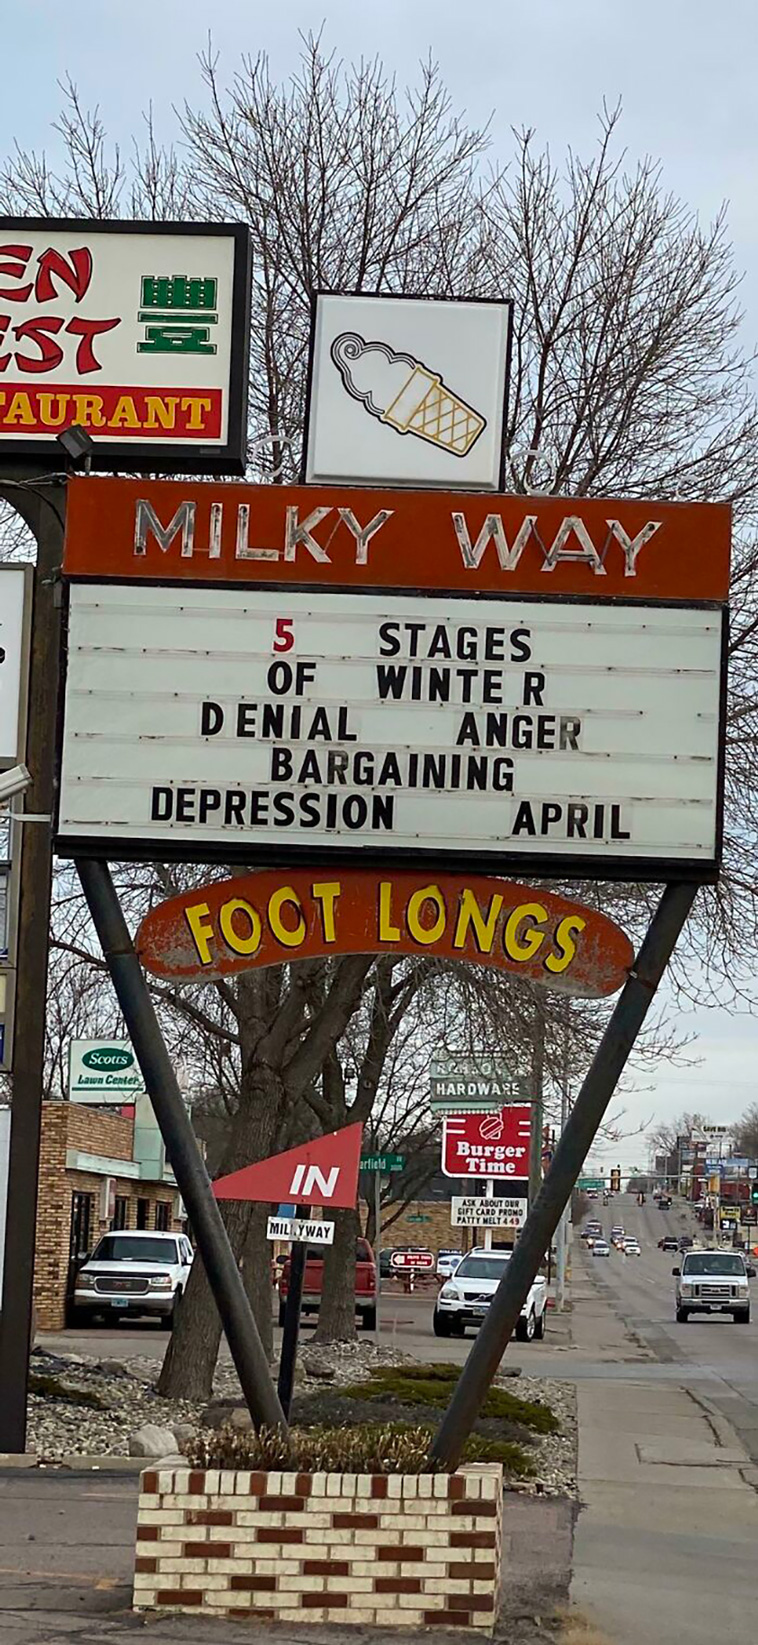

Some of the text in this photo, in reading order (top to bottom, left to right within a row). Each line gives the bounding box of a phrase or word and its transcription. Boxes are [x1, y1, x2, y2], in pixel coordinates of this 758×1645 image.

[0, 391, 211, 430] AURANT
[133, 499, 663, 577] MILKY WAY
[272, 618, 532, 662] 5 STAGES
[267, 660, 316, 696] OF
[201, 701, 581, 750] DENIAL ANGER
[270, 747, 515, 792] BARGAINING
[151, 786, 630, 839] DEPRESSION APRIL
[184, 881, 586, 974] FOOT LONGS
[88, 1052, 129, 1066] Scotts
[77, 1074, 139, 1085] Lawn Center
[436, 1082, 520, 1096] HARDWARE
[360, 1158, 386, 1169] arfield
[456, 1141, 526, 1160] Burger
[465, 1157, 516, 1174] Time
[289, 1164, 340, 1198] IN
[457, 1208, 524, 1217] GIFT CARD PROMO
[461, 1199, 520, 1208] ASK ABOUT OUR
[456, 1216, 481, 1225] PATTY
[483, 1217, 501, 1225] MELT
